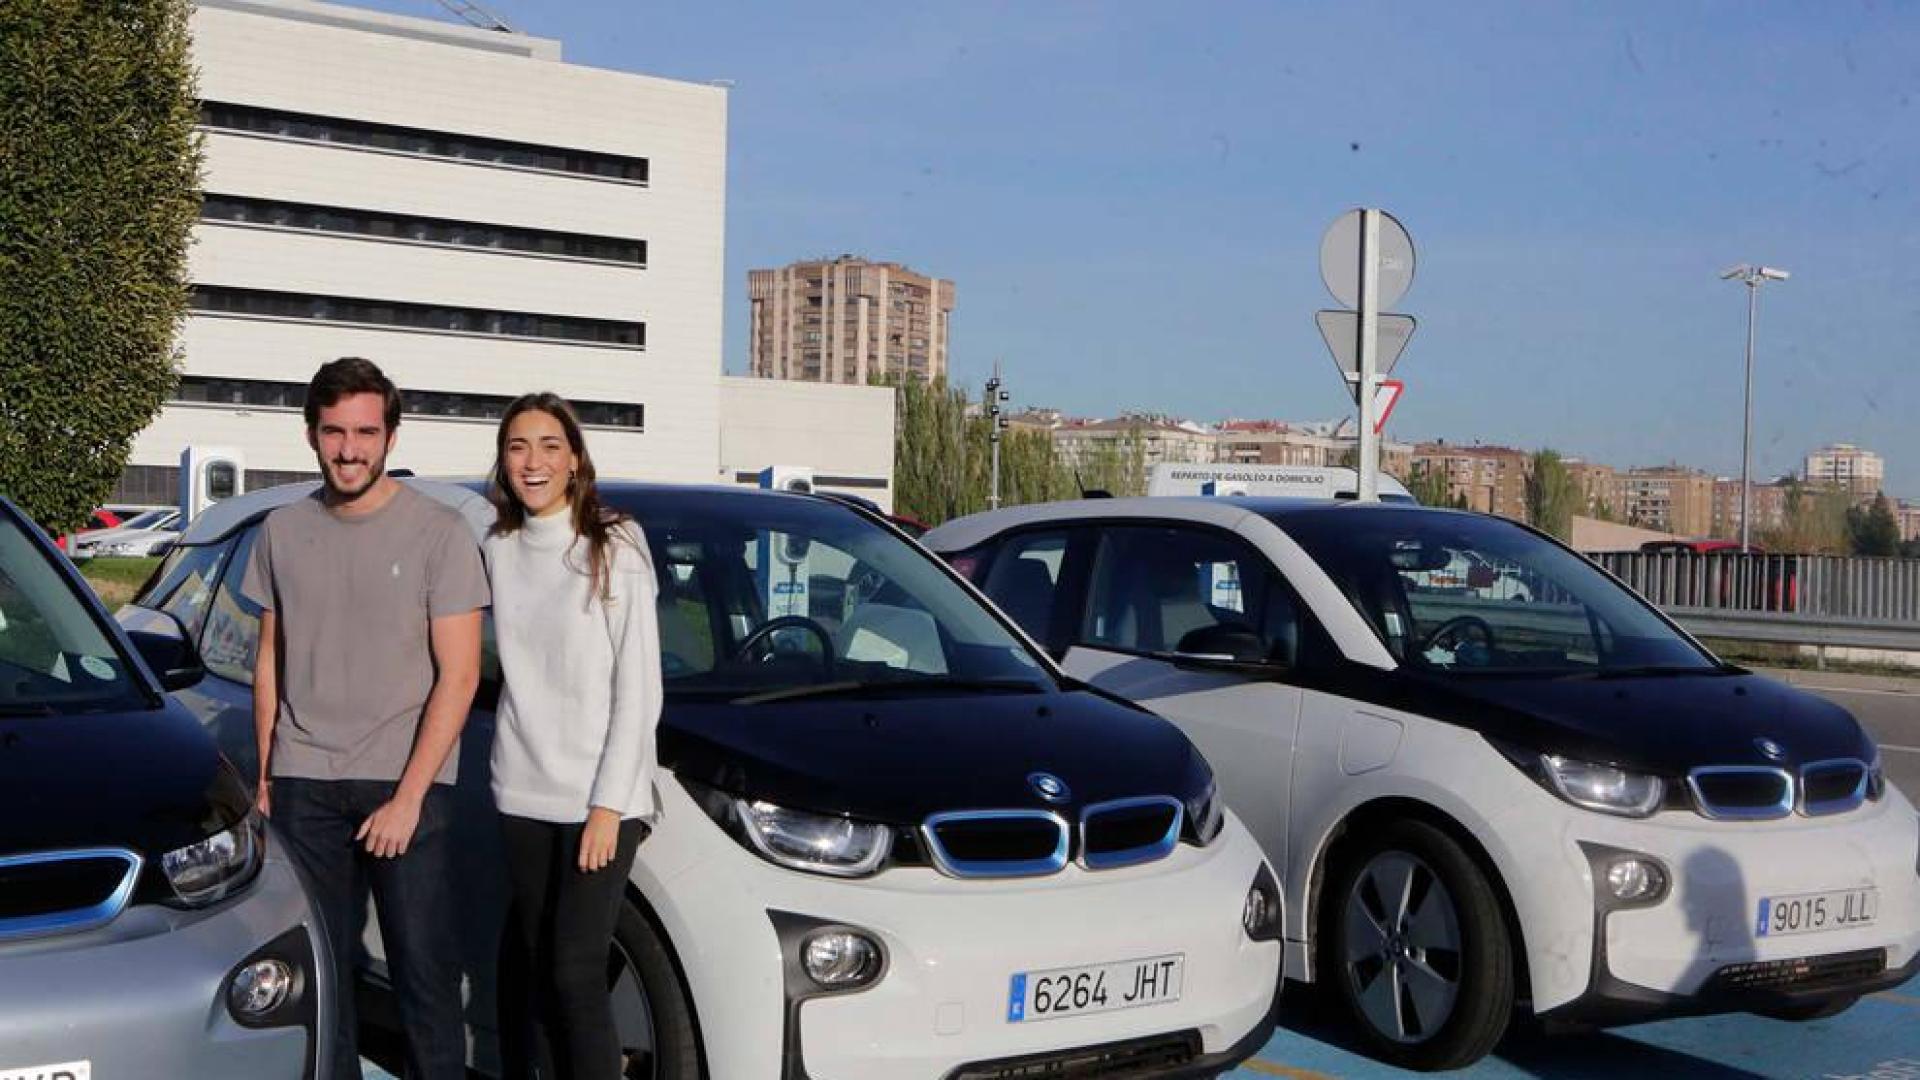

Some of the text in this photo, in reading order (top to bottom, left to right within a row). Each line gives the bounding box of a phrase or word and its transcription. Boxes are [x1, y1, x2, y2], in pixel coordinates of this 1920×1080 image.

[1171, 471, 1211, 480] REPARTO
[1775, 891, 1870, 931] 9015 JLL
[1034, 961, 1176, 1013] 6264 JHT
